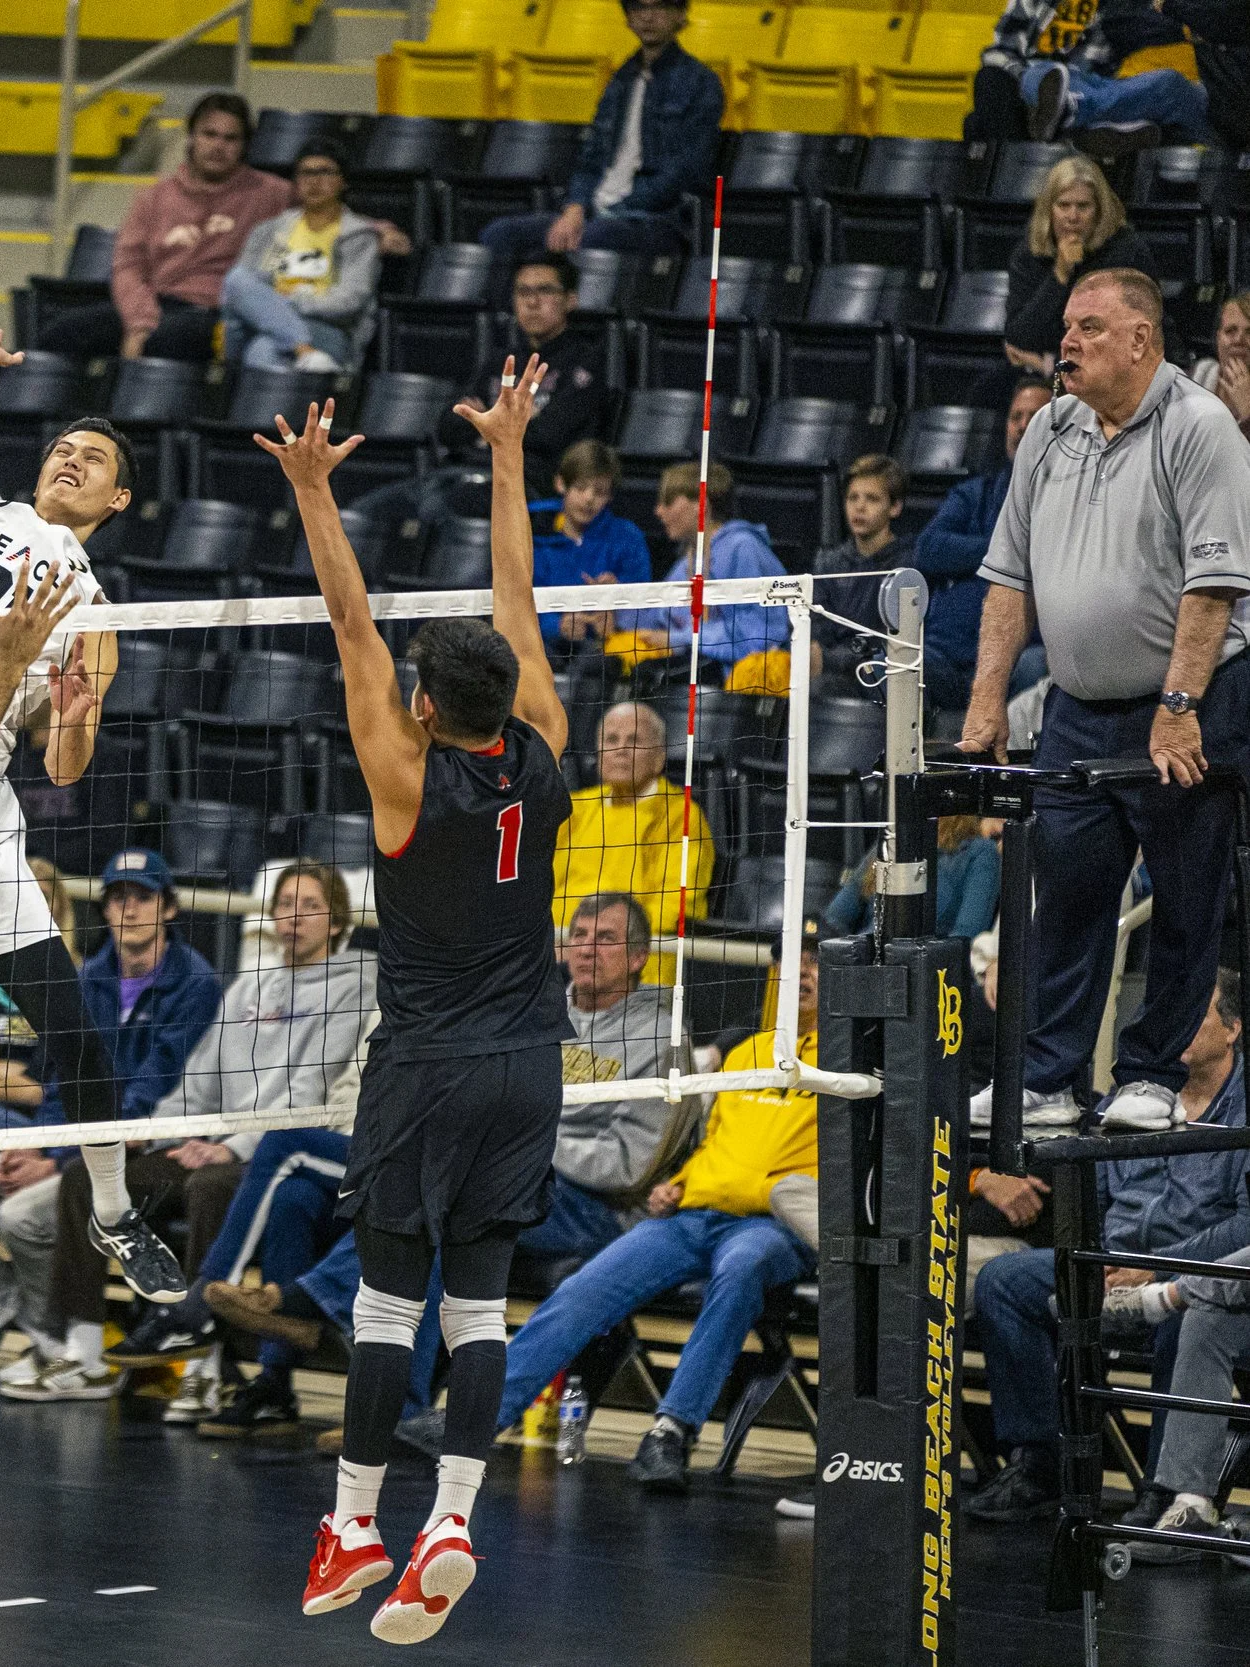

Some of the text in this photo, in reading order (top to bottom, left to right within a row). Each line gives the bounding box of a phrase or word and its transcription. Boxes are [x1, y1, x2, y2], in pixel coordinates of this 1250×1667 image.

[780, 581, 800, 589] Senoh
[496, 800, 523, 883] 1
[928, 1116, 951, 1300] STATE
[925, 1318, 943, 1515] BEACH
[940, 1204, 960, 1600] MEN'S VOLLEYBALL
[848, 1460, 903, 1482] asics
